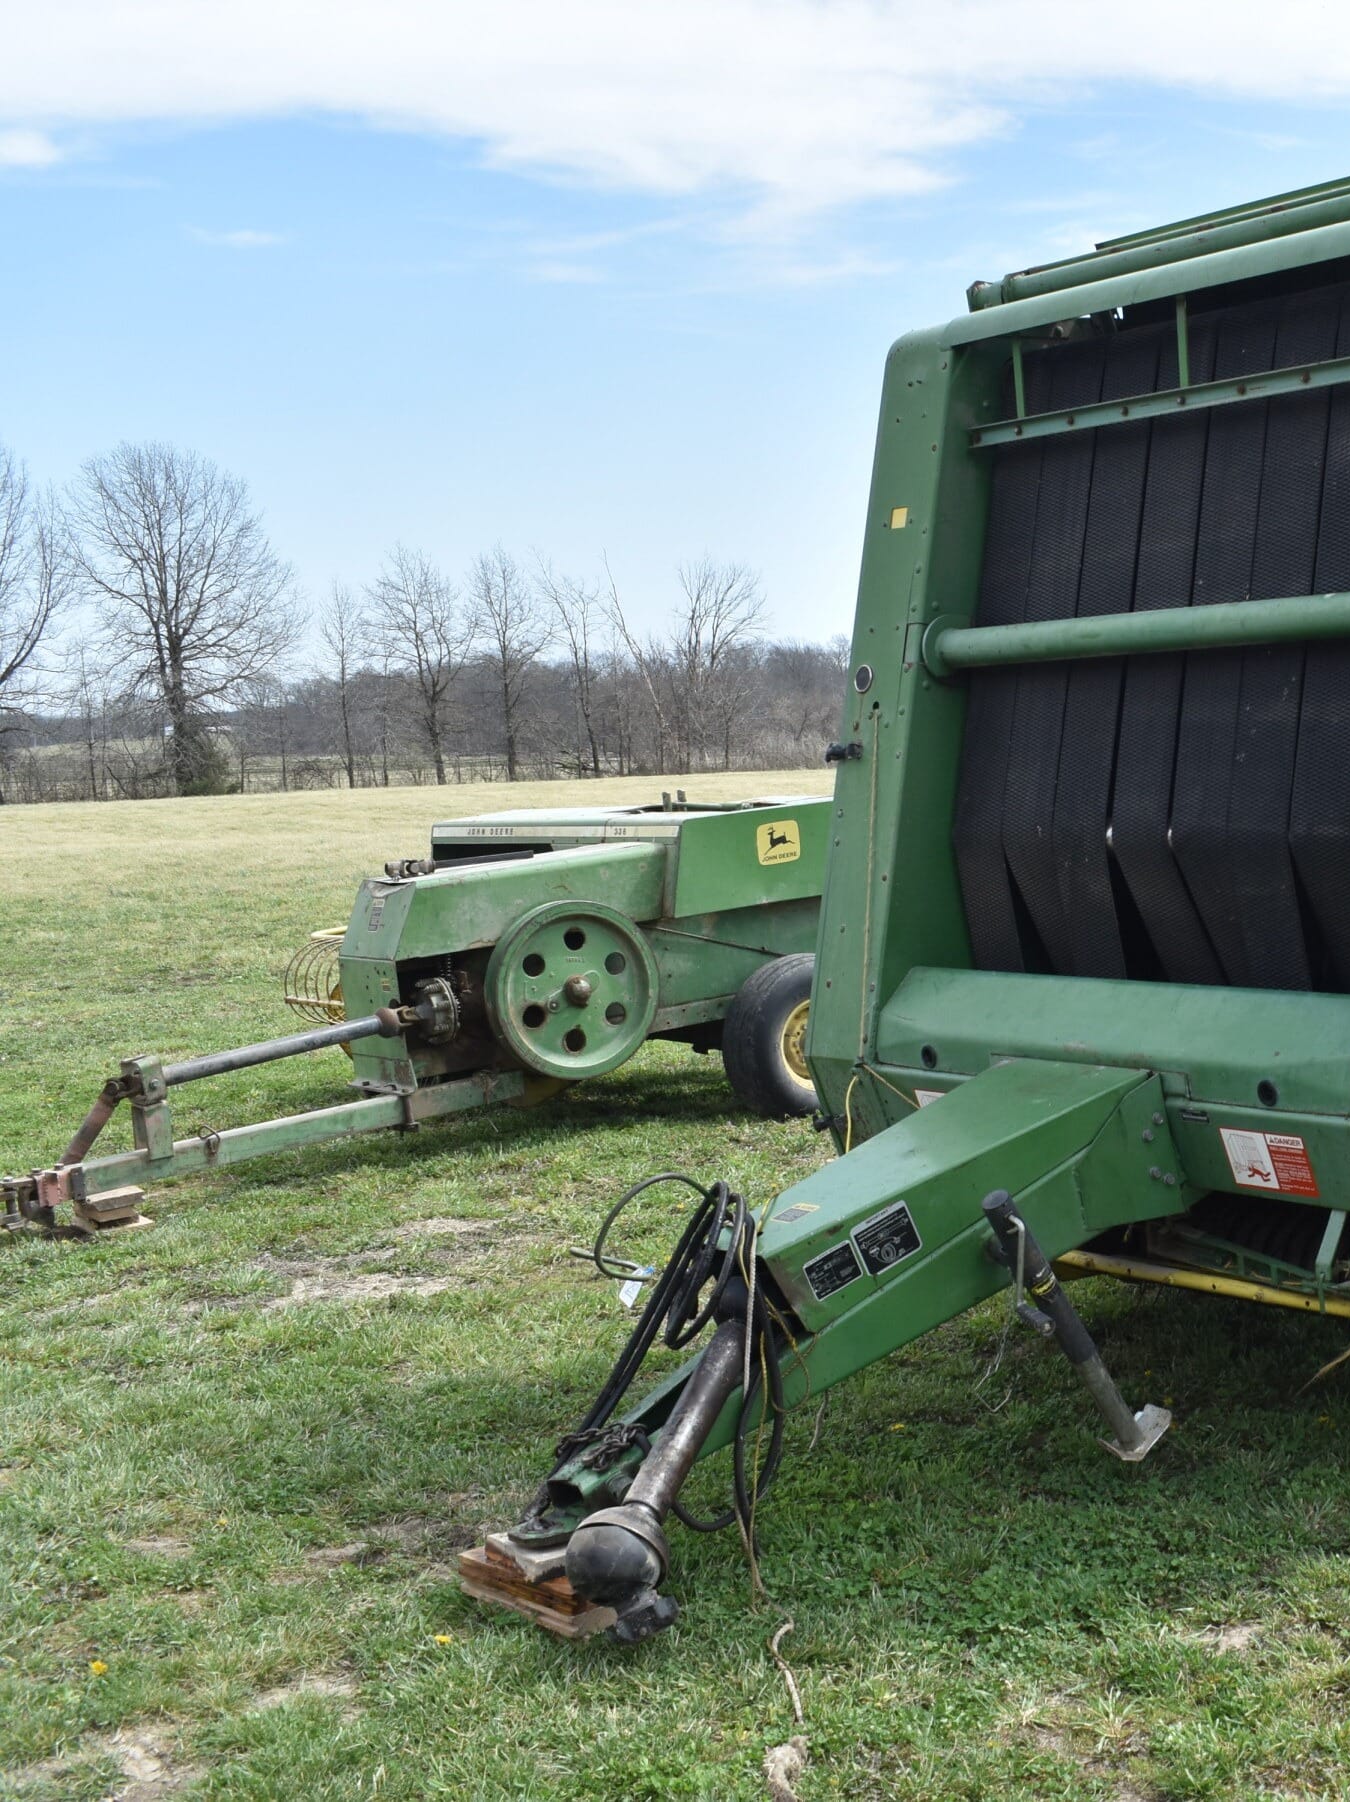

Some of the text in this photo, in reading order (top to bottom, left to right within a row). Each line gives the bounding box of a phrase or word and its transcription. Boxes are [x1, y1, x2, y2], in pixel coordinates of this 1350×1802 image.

[467, 828, 514, 836] JOHN DEERE
[762, 851, 797, 863] JOHN DEERE
[1274, 1136, 1302, 1147] DANGER
